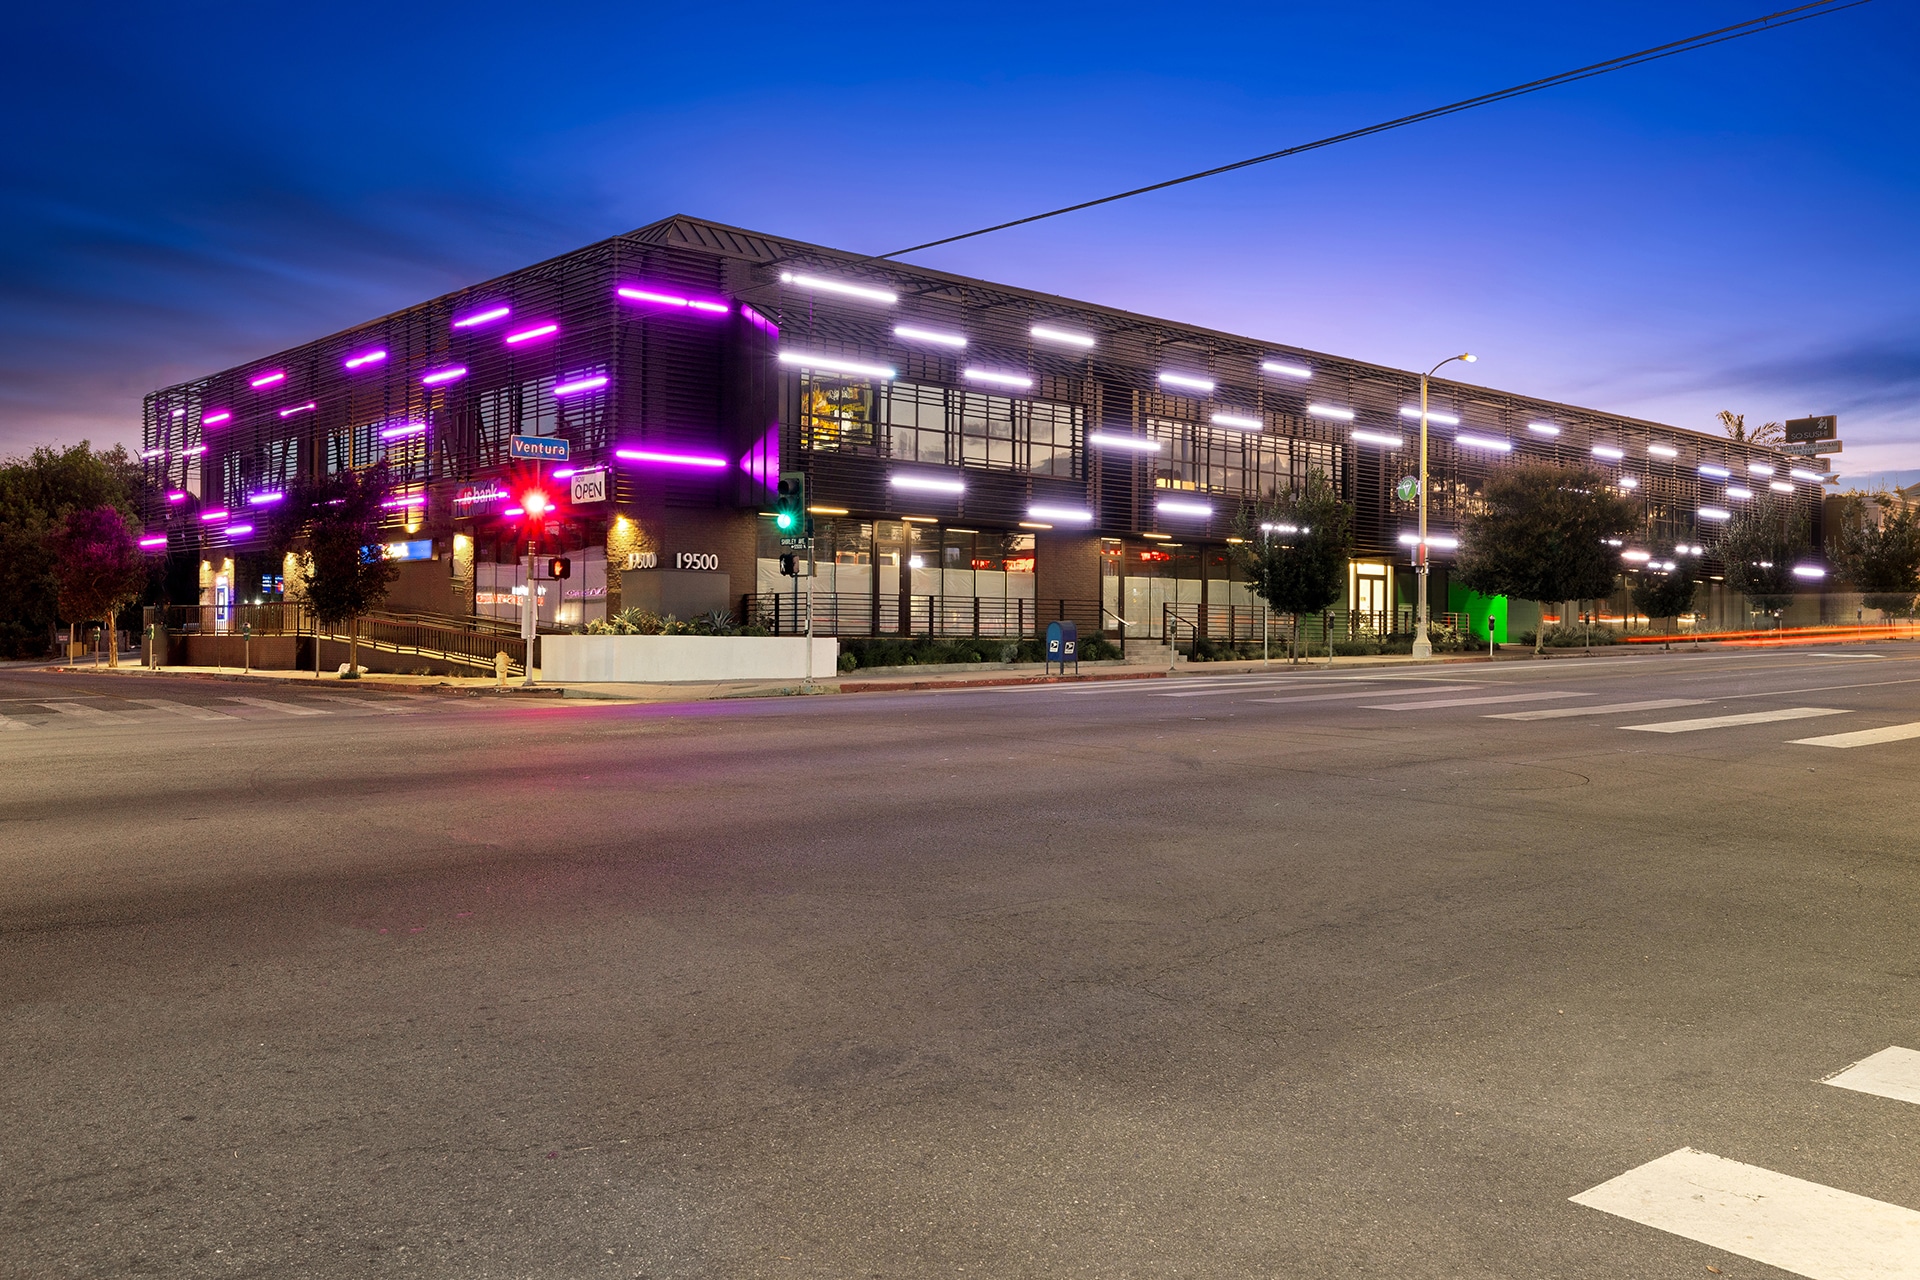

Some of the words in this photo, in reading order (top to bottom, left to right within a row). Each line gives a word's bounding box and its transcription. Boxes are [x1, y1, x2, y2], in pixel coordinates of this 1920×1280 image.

[1804, 430, 1828, 438] SUSHI
[515, 440, 566, 455] Ventura
[574, 481, 602, 500] OPEN
[781, 538, 797, 546] SHIRLEY
[676, 552, 718, 570] 19500
